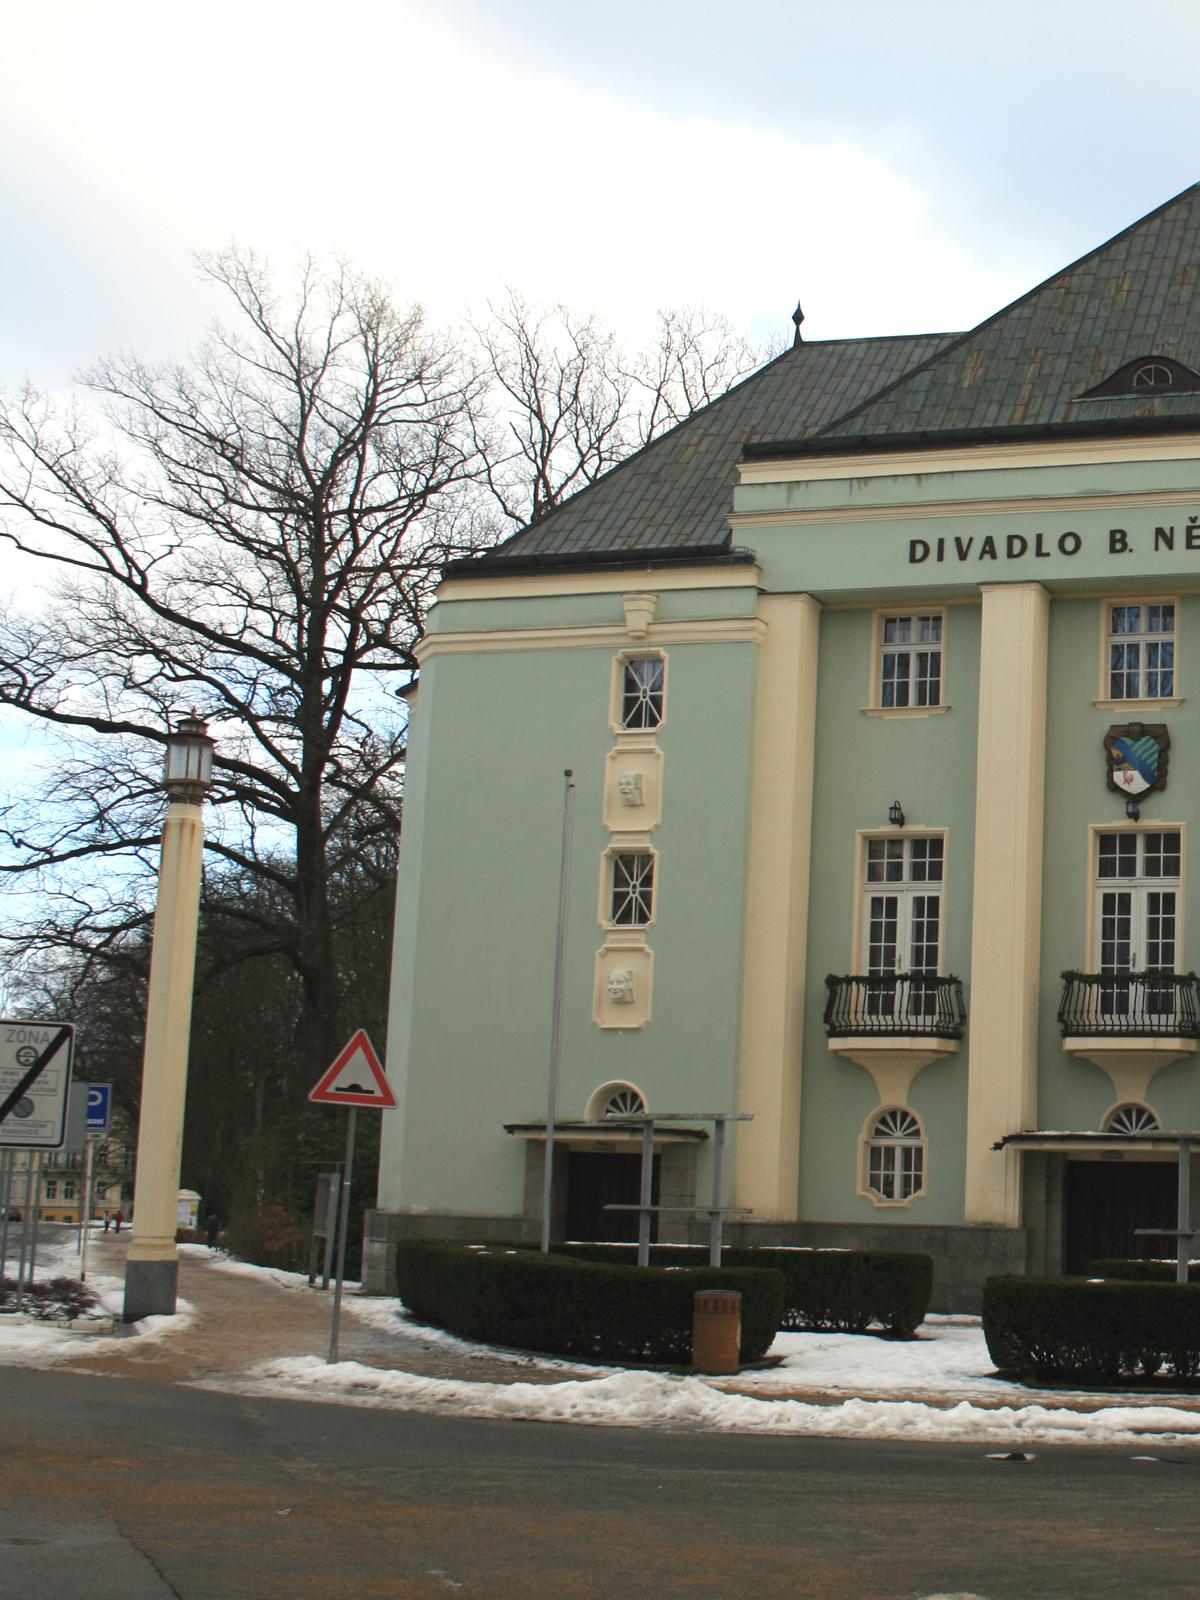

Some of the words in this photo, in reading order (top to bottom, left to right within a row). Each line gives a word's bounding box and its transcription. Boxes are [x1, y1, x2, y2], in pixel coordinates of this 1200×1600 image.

[909, 532, 1083, 564] DIVADLO
[1109, 528, 1134, 554] B.
[6, 1027, 51, 1044] ZÓNA
